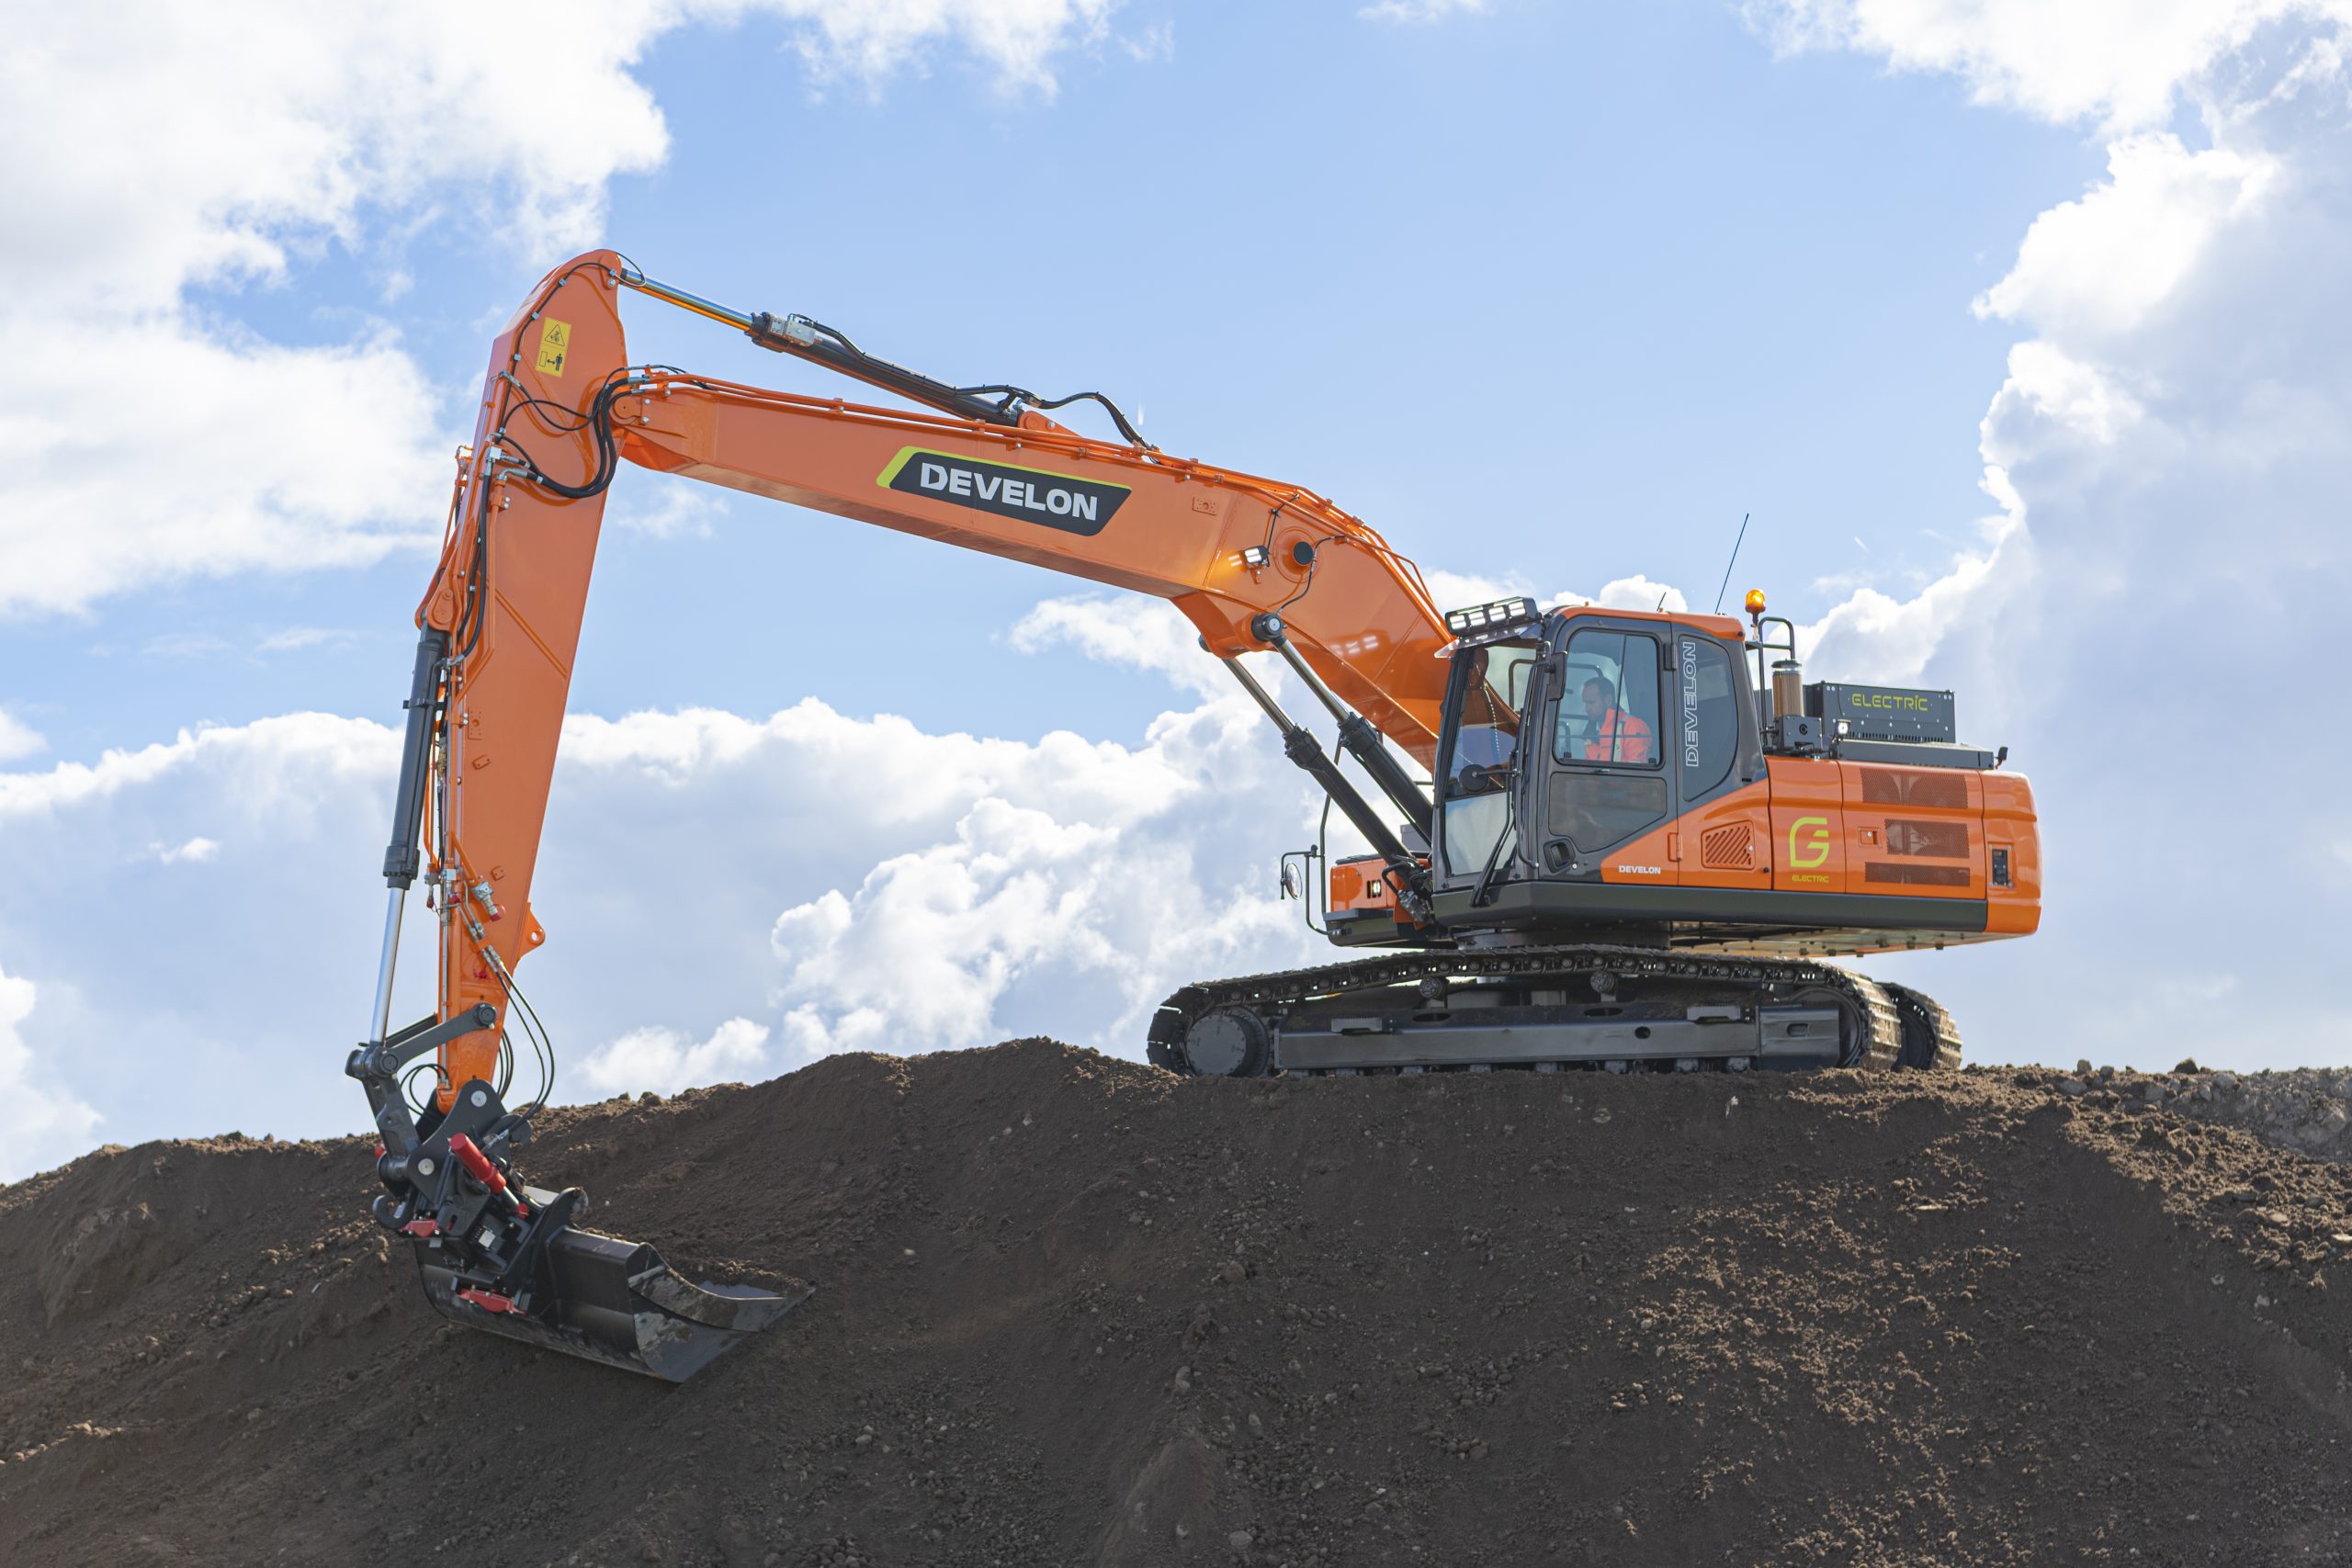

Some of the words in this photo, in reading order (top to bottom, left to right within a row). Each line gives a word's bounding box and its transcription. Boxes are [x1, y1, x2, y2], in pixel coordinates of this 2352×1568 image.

[920, 462, 1098, 521] DEVELON
[1683, 642, 1699, 767] DEVELON
[1619, 865, 1661, 874] DEVELON
[1792, 874, 1829, 883] ELECTRIC
